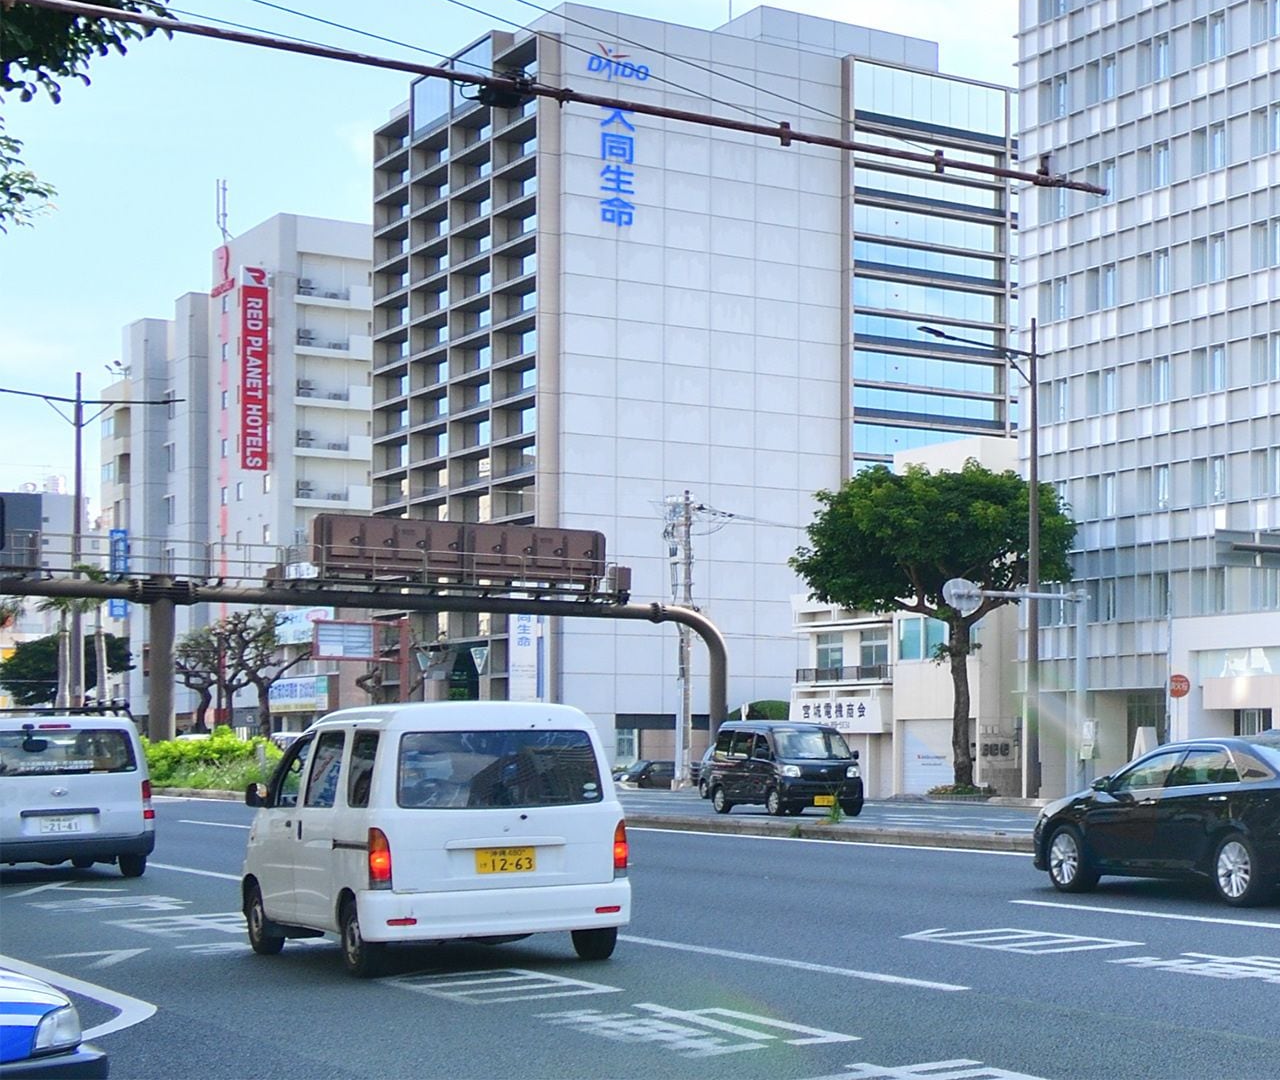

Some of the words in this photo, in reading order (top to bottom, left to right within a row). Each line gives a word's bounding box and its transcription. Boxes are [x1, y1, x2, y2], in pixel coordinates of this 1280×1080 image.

[586, 51, 650, 81] DAIDO
[600, 106, 636, 227] 大同生命
[246, 297, 263, 330] RED
[246, 336, 263, 400] PLANET
[246, 404, 263, 468] HOTELS
[492, 856, 533, 871] 12-63
